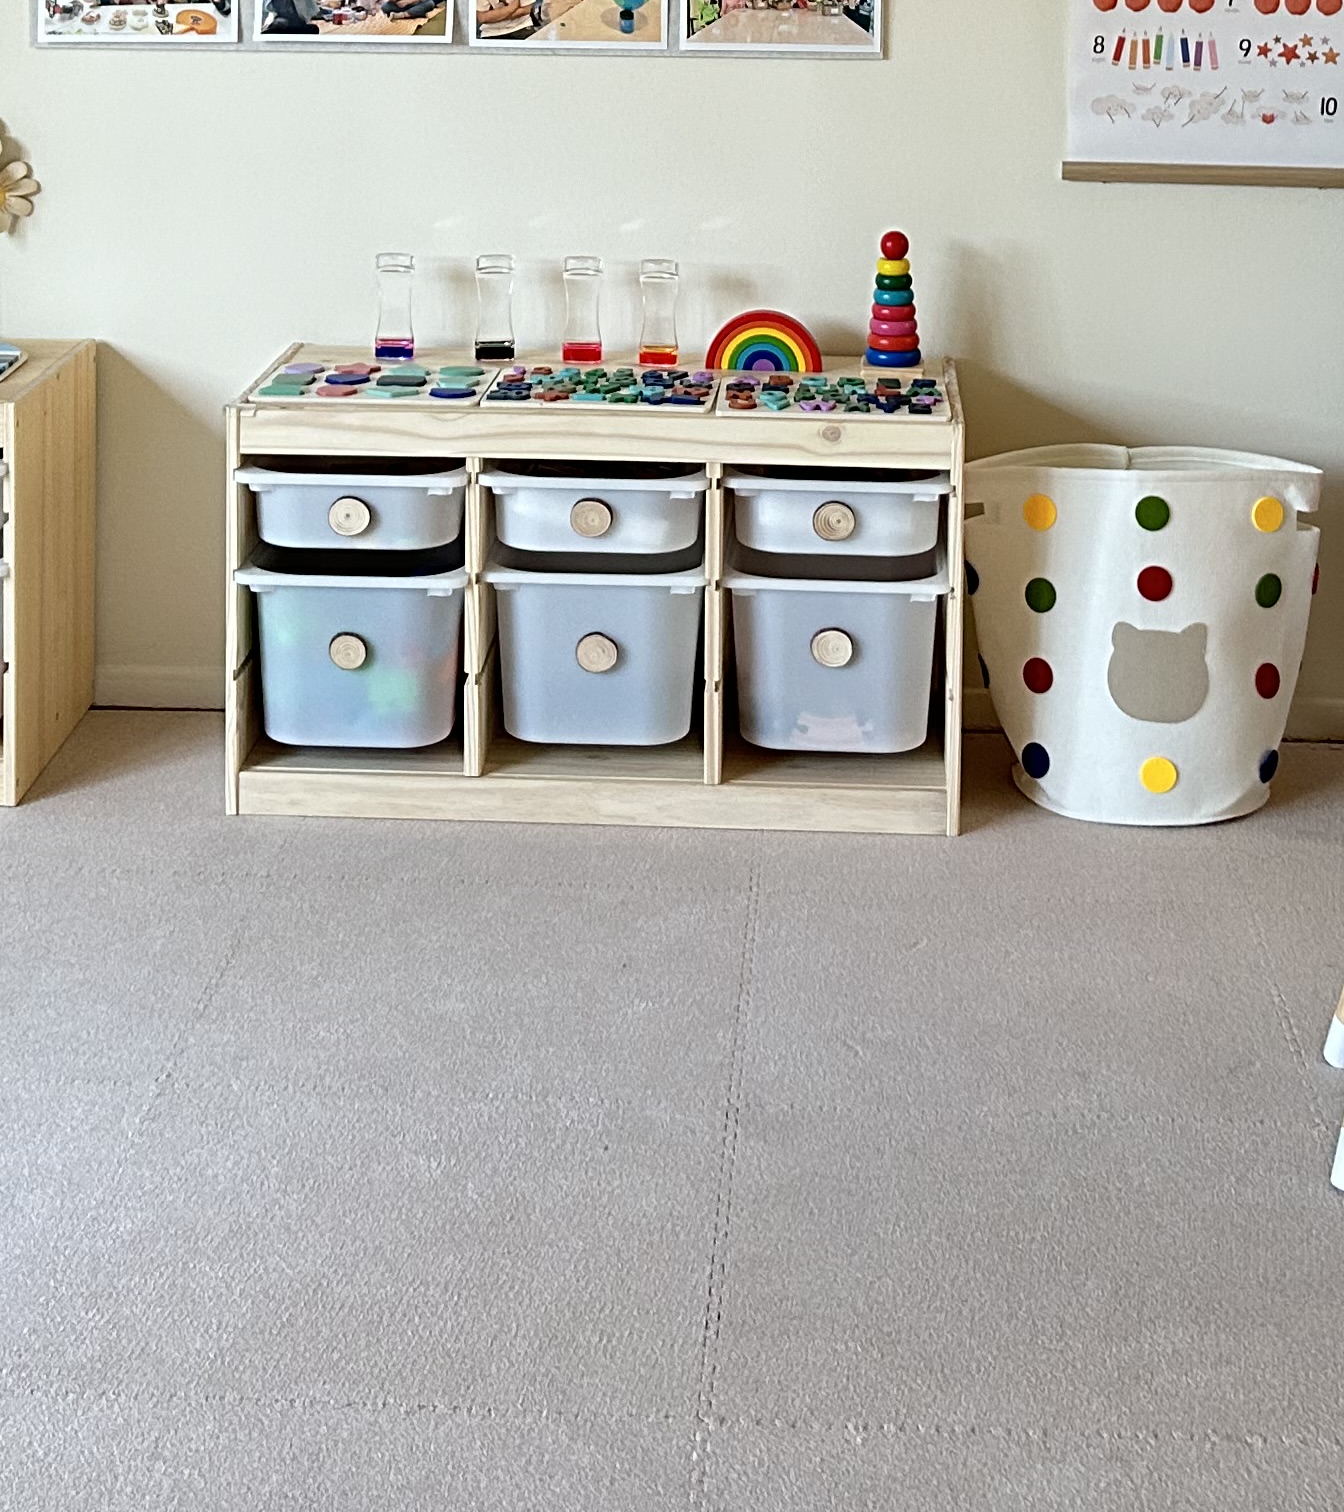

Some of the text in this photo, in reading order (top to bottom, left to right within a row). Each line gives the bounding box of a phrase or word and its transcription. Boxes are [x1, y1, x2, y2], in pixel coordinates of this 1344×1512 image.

[1092, 35, 1105, 54] 8
[1238, 38, 1252, 58] 9
[1320, 96, 1338, 117] 10
